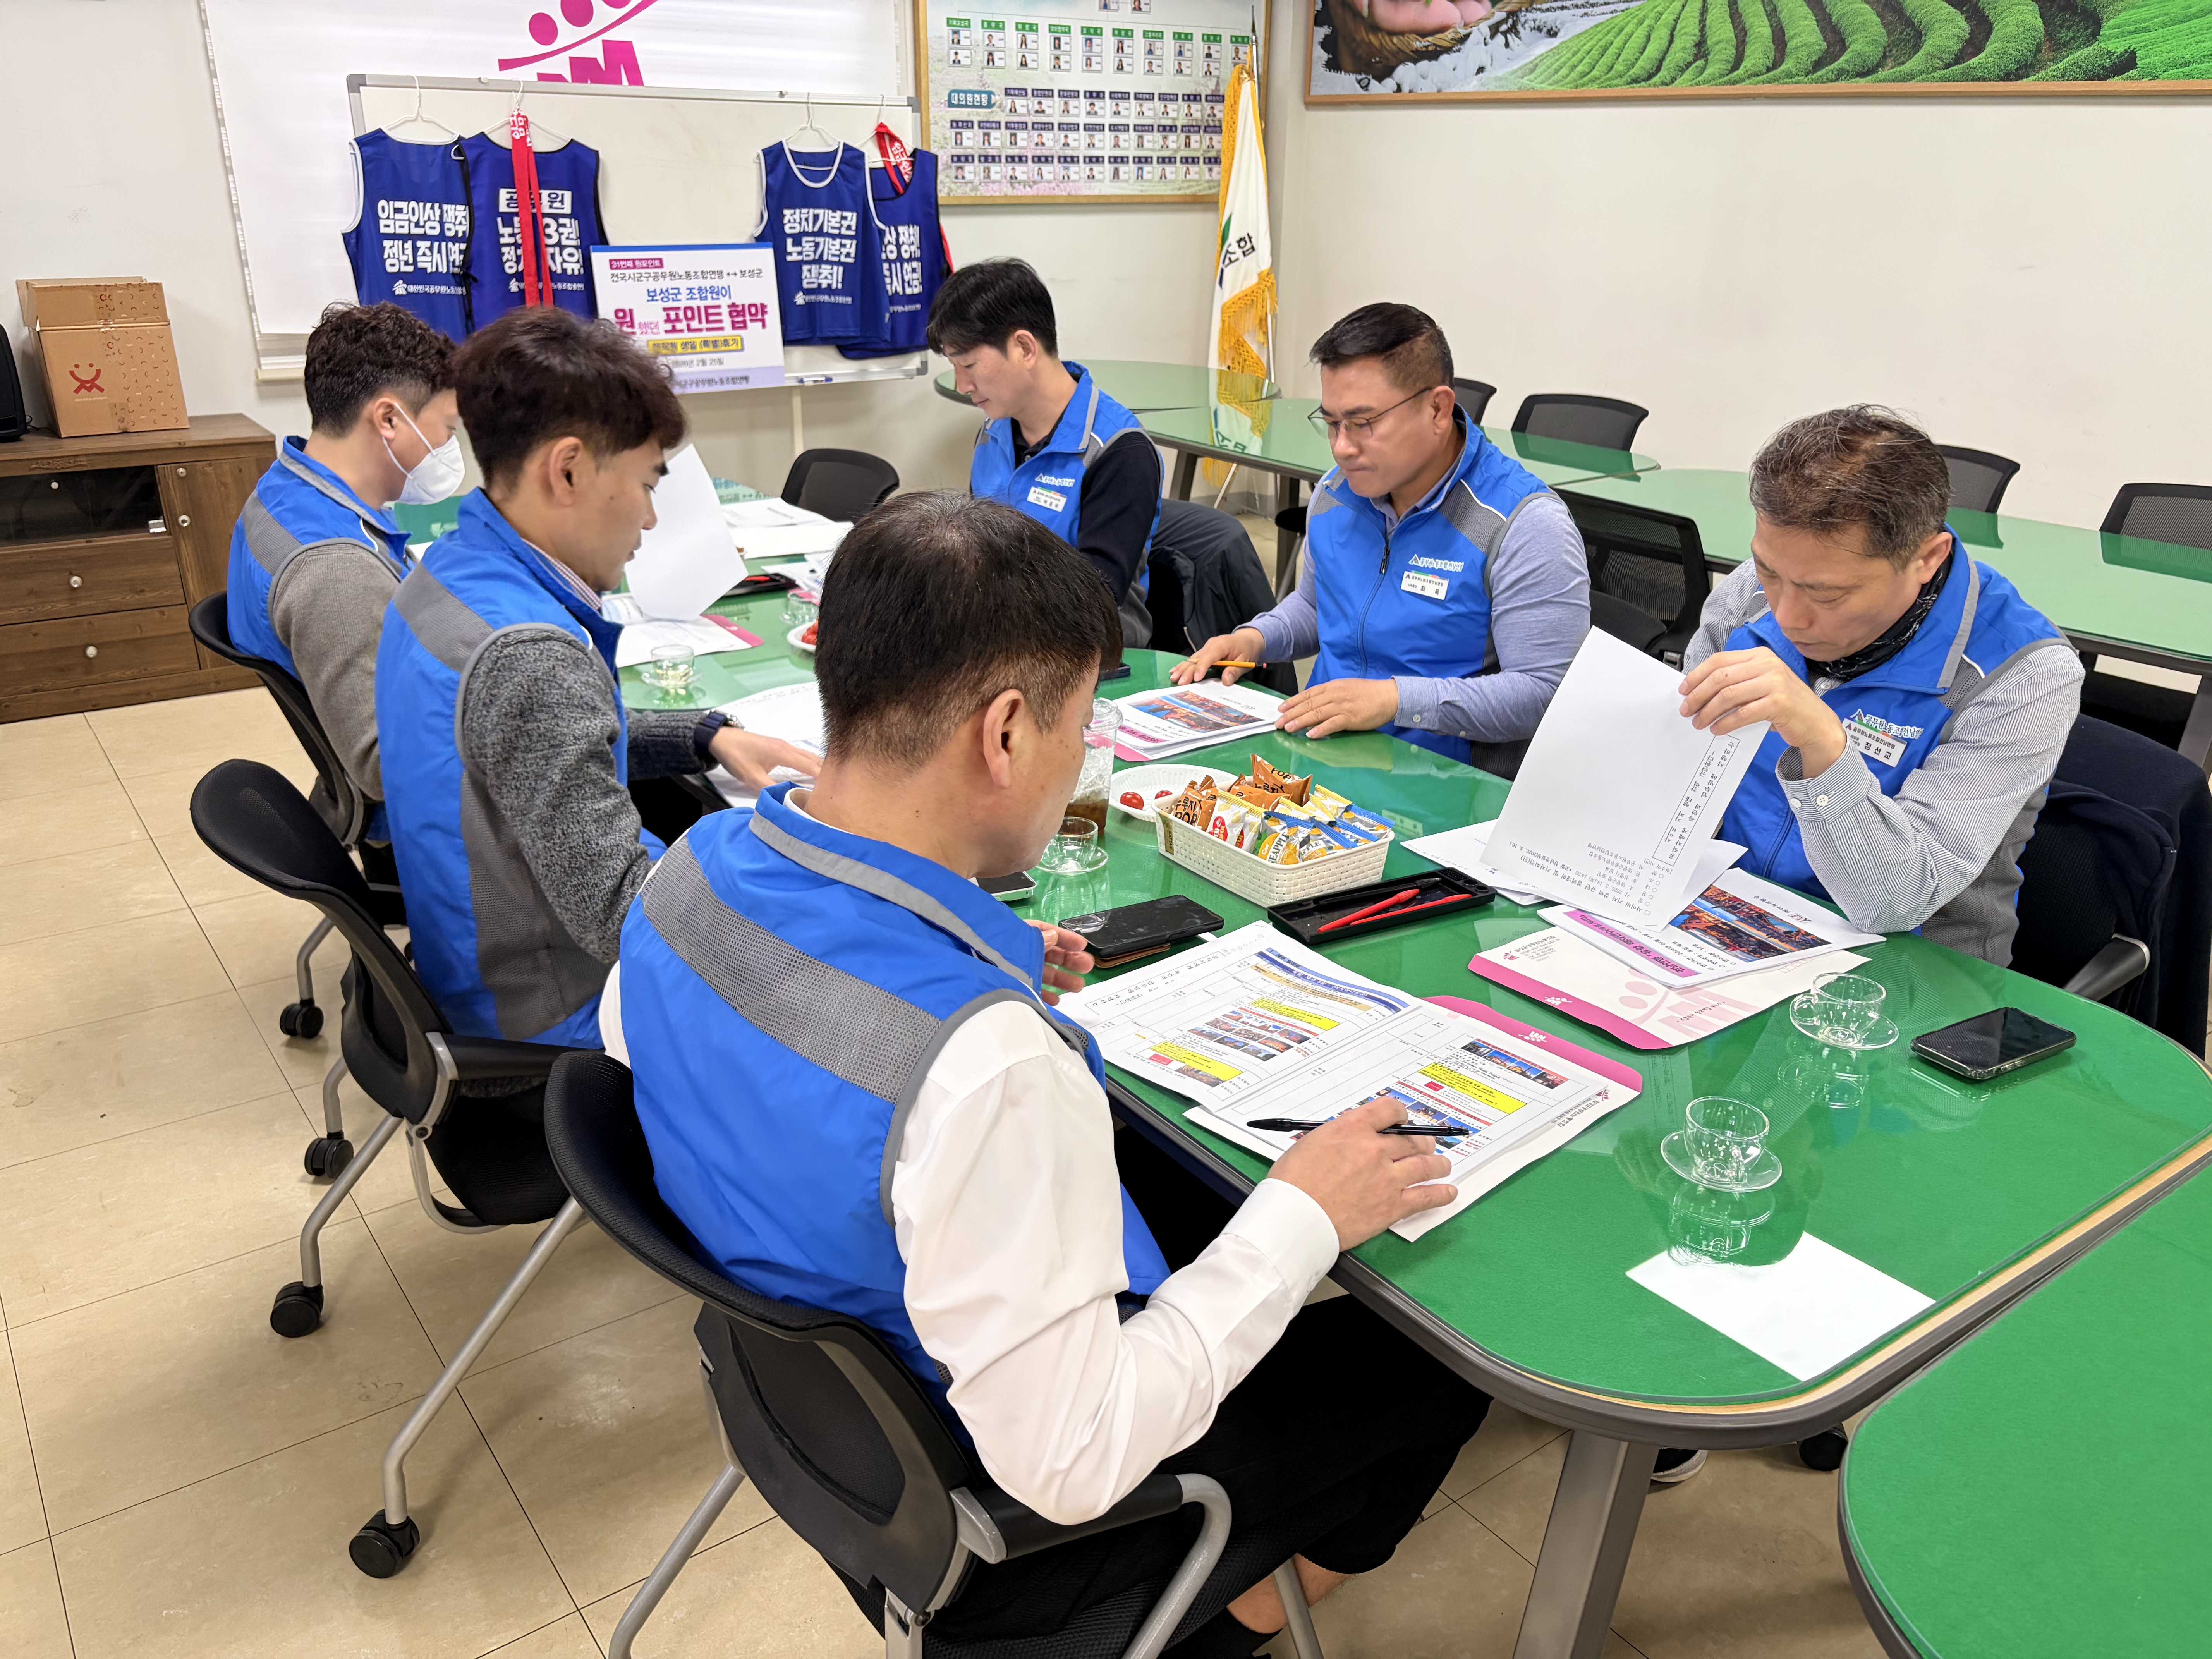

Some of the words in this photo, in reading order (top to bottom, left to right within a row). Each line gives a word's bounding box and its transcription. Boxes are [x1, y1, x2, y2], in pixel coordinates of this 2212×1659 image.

[951, 93, 988, 106] 대의원현황
[505, 191, 566, 210] 공원
[378, 199, 441, 235] 임금인상
[782, 208, 857, 236] 정치기본권
[786, 237, 857, 263] 노동기본권
[881, 226, 897, 261] 상
[382, 240, 414, 273] 정년
[416, 240, 447, 274] 즉시
[739, 268, 763, 279] 보성군
[801, 264, 843, 289] 쟁취!
[647, 287, 682, 302] 보성군
[686, 285, 732, 301] 조합원이
[614, 308, 637, 336] 원
[662, 304, 725, 334] 포인트
[728, 302, 768, 331] 협약
[1668, 827, 1690, 860] 공직자에게
[1687, 803, 1702, 822] 폭언과
[1700, 773, 1718, 799] 업무방해
[1716, 741, 1735, 768] 자행하는
[1663, 826, 1678, 843] 사이비
[1674, 811, 1686, 823] 기자
[1519, 854, 1552, 873] 기자회견(안)
[1560, 872, 1583, 887] 결의대회
[1574, 870, 1587, 879] 14:00
[1597, 889, 1611, 899] 강력
[1609, 885, 1623, 895] 2026.
[1611, 894, 1624, 905] 기자
[1625, 900, 1643, 912] 사이비
